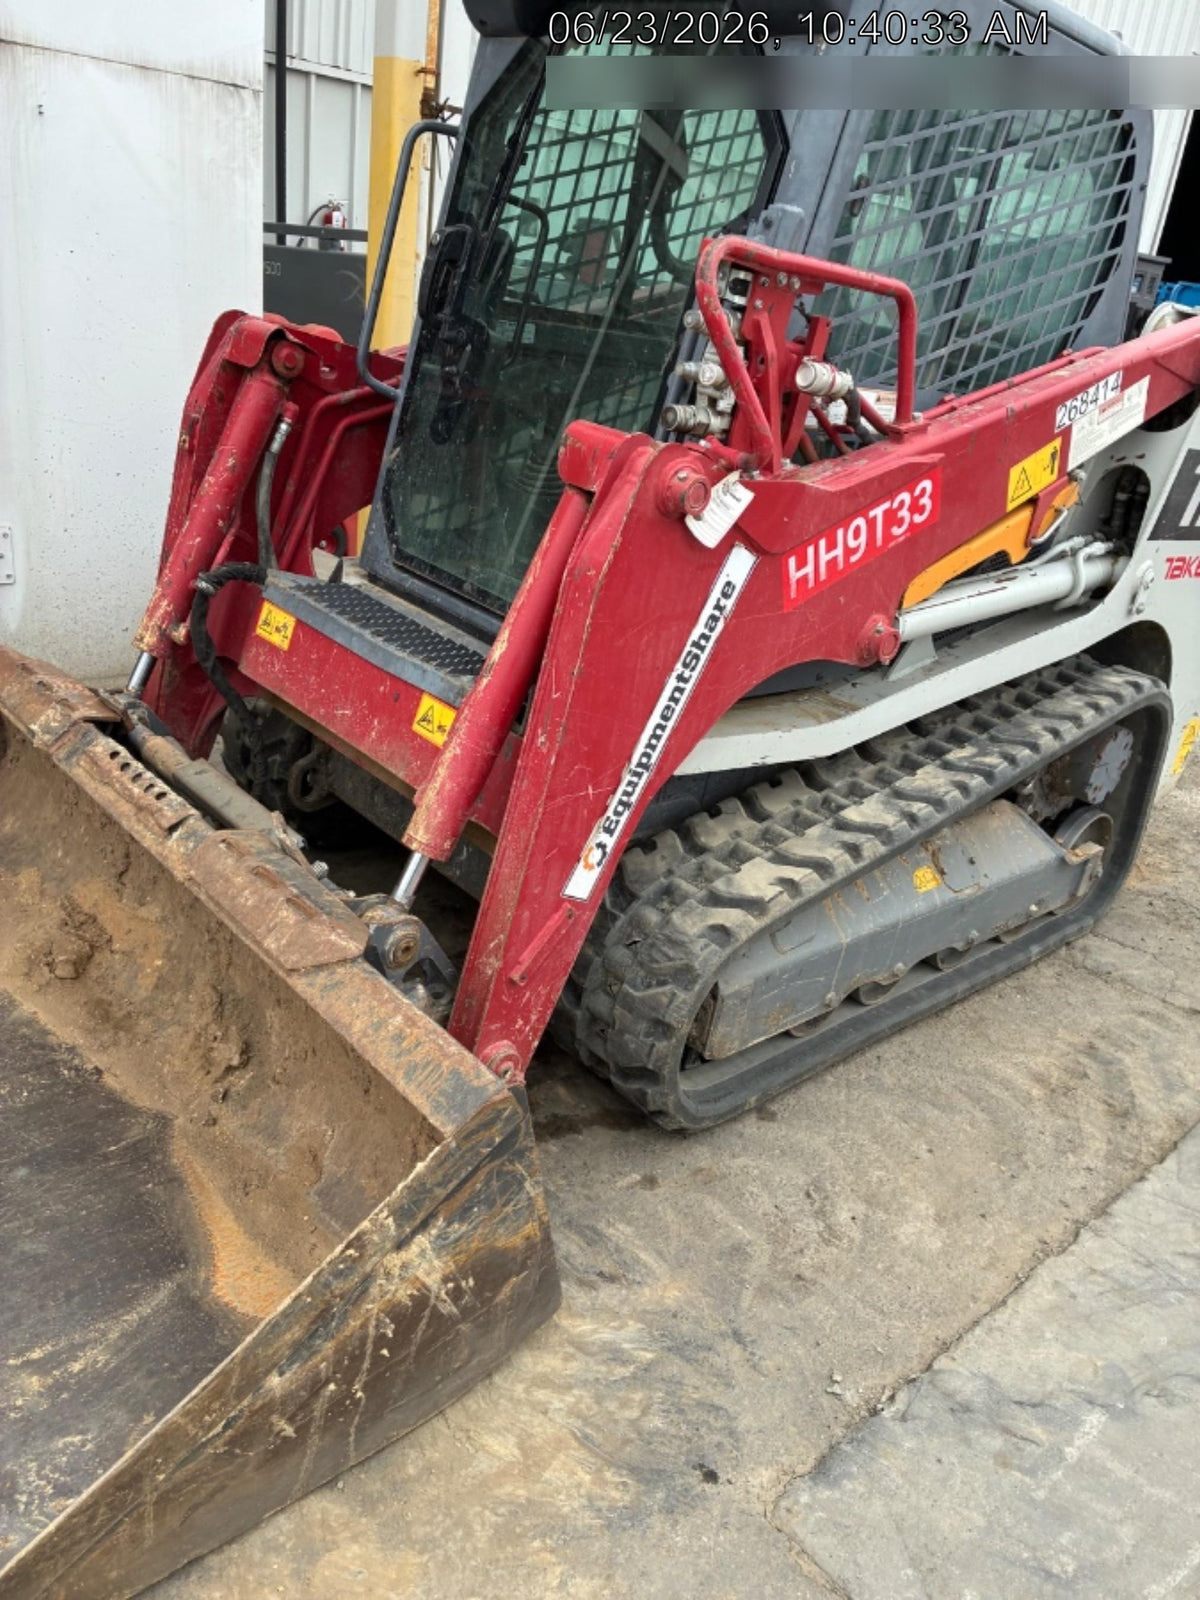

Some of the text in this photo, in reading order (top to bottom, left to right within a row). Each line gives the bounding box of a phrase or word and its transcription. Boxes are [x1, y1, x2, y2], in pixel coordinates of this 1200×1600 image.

[1056, 371, 1121, 430] 268414
[788, 479, 933, 599] HH9T33
[603, 579, 736, 838] EquipmentShare
